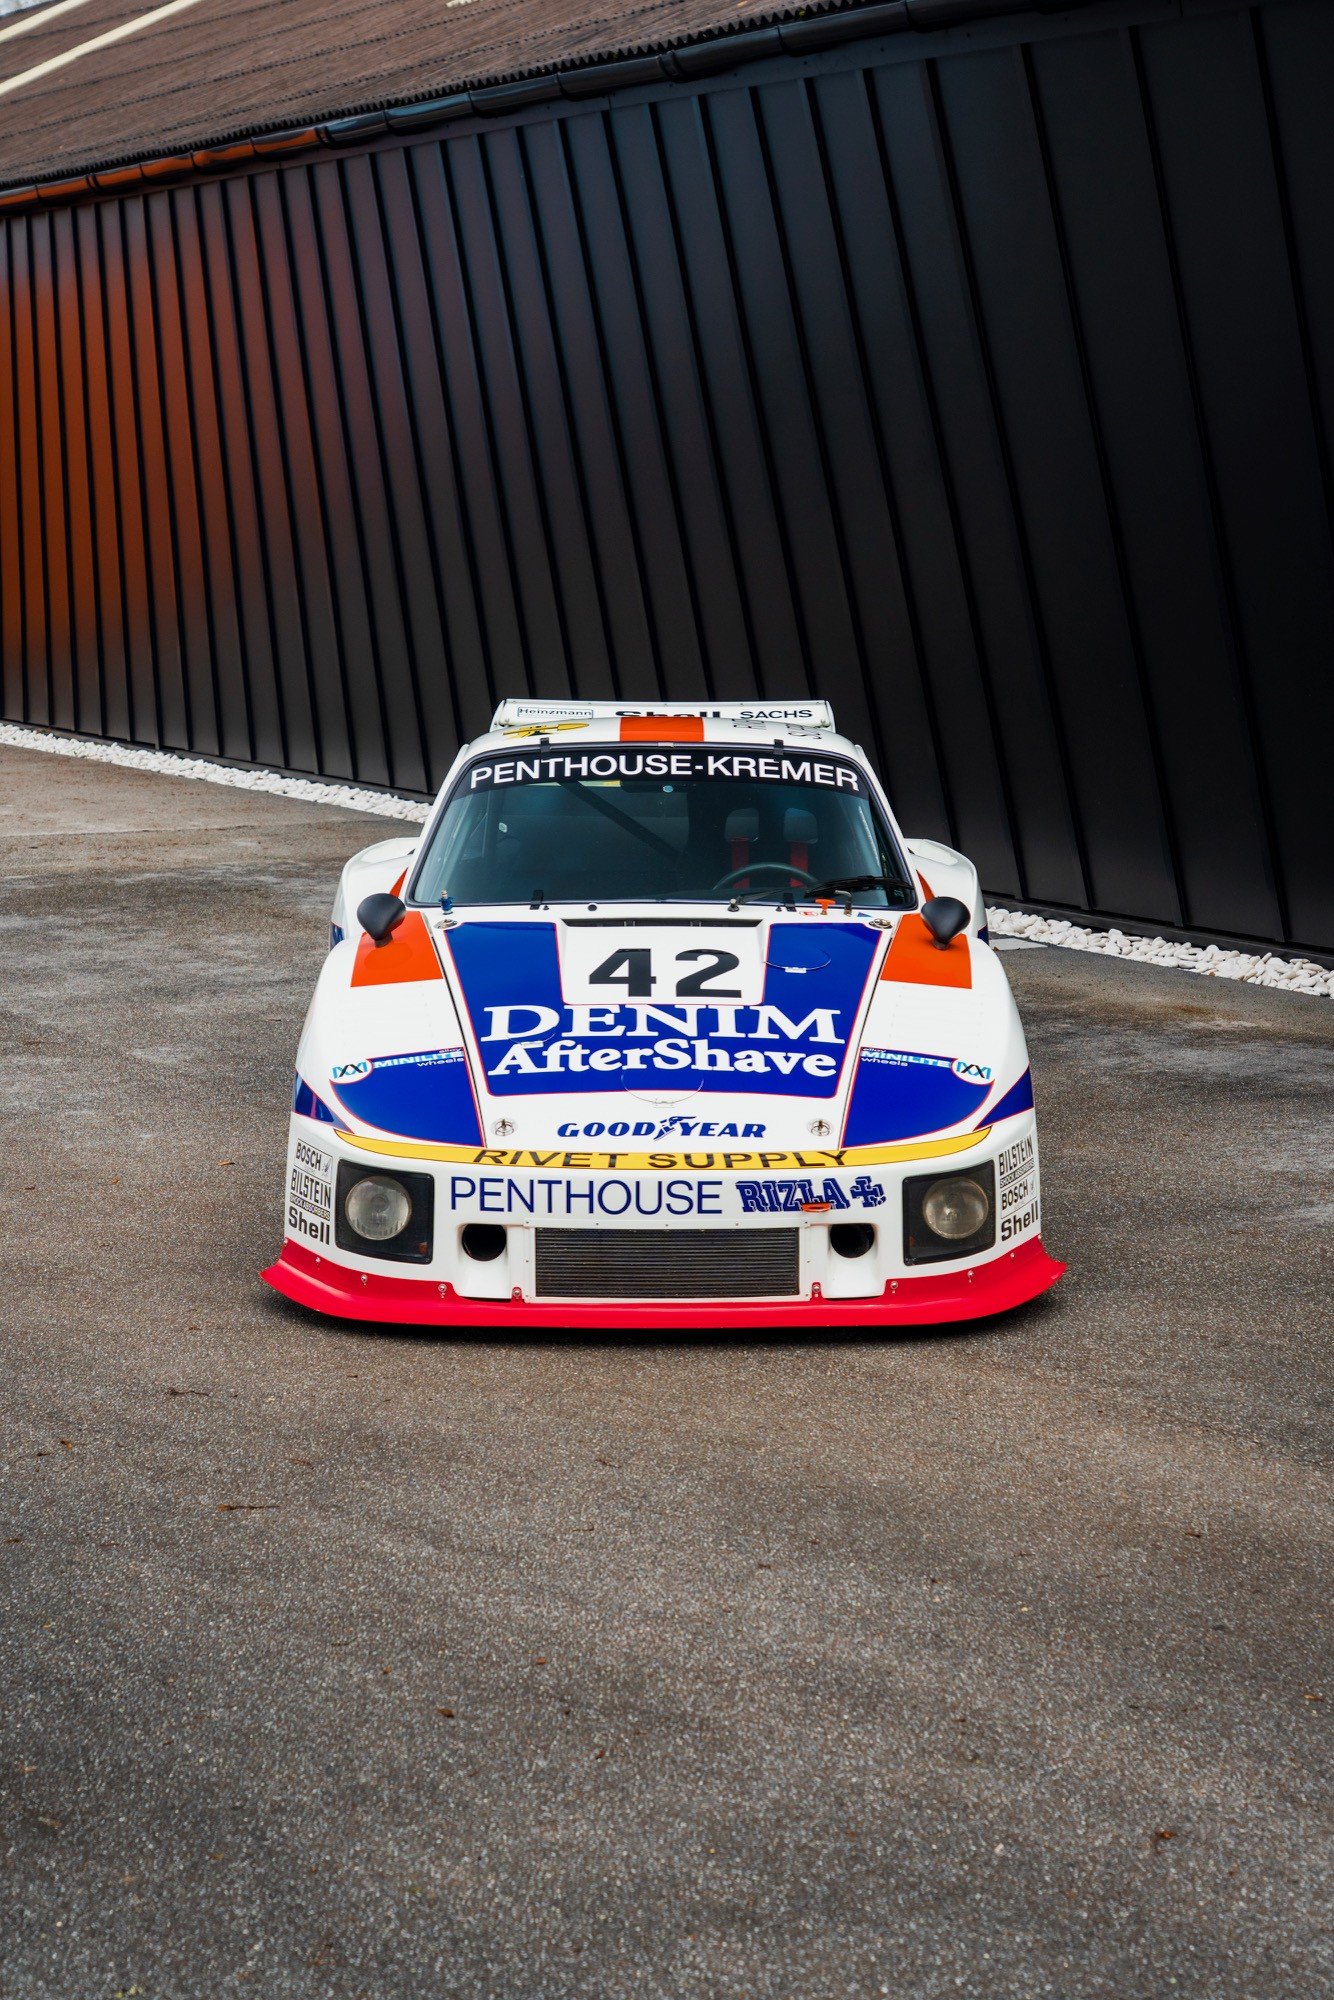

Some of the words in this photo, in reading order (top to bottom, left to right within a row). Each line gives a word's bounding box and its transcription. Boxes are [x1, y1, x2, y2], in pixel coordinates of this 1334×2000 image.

[519, 708, 592, 716] Heinzmann
[740, 709, 813, 720] SACHS
[469, 754, 860, 792] PENTHOUSE-KREMER
[589, 948, 742, 999] 42
[480, 1004, 846, 1045] DENIM
[373, 1051, 464, 1069] MINILITE
[416, 1057, 464, 1068] wheels
[487, 1039, 838, 1078] AfterShave
[860, 1050, 951, 1069] MINILITE
[860, 1057, 909, 1067] wheels
[296, 1142, 322, 1172] BOSCH
[472, 1150, 629, 1169] RIVET
[647, 1150, 848, 1170] SUPPLY
[998, 1134, 1034, 1177] BILSTEIN
[290, 1168, 332, 1210] BILSTEIN
[451, 1176, 723, 1215] PENTHOUSE
[1001, 1179, 1029, 1211] BOSCH
[288, 1205, 331, 1246] Shell
[1001, 1200, 1039, 1242] Shell
